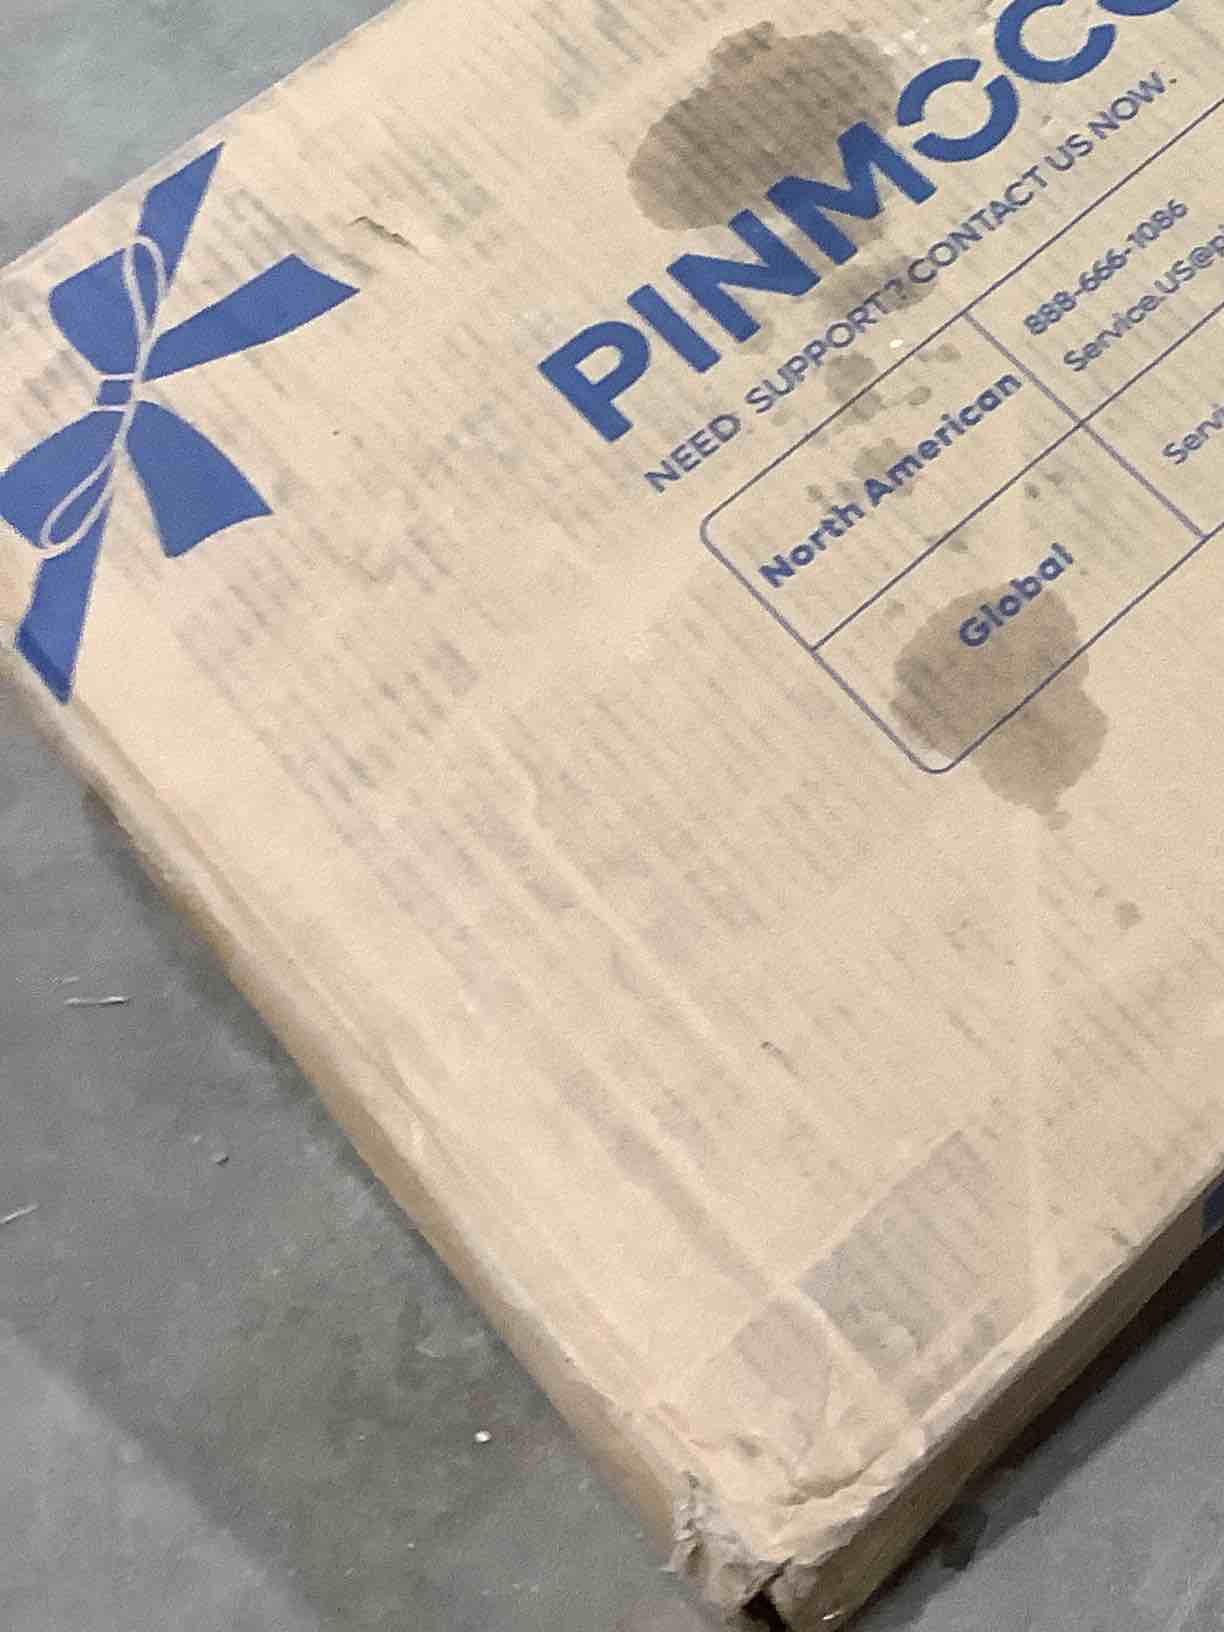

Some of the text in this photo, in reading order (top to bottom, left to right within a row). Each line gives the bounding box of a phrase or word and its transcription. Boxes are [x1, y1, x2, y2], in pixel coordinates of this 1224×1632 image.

[644, 71, 1177, 493] NEED SUPPORT? CONTACT US NOW.
[1023, 198, 1189, 336] 888-666-1086
[758, 373, 1022, 588] North American
[958, 542, 1074, 647] Global
